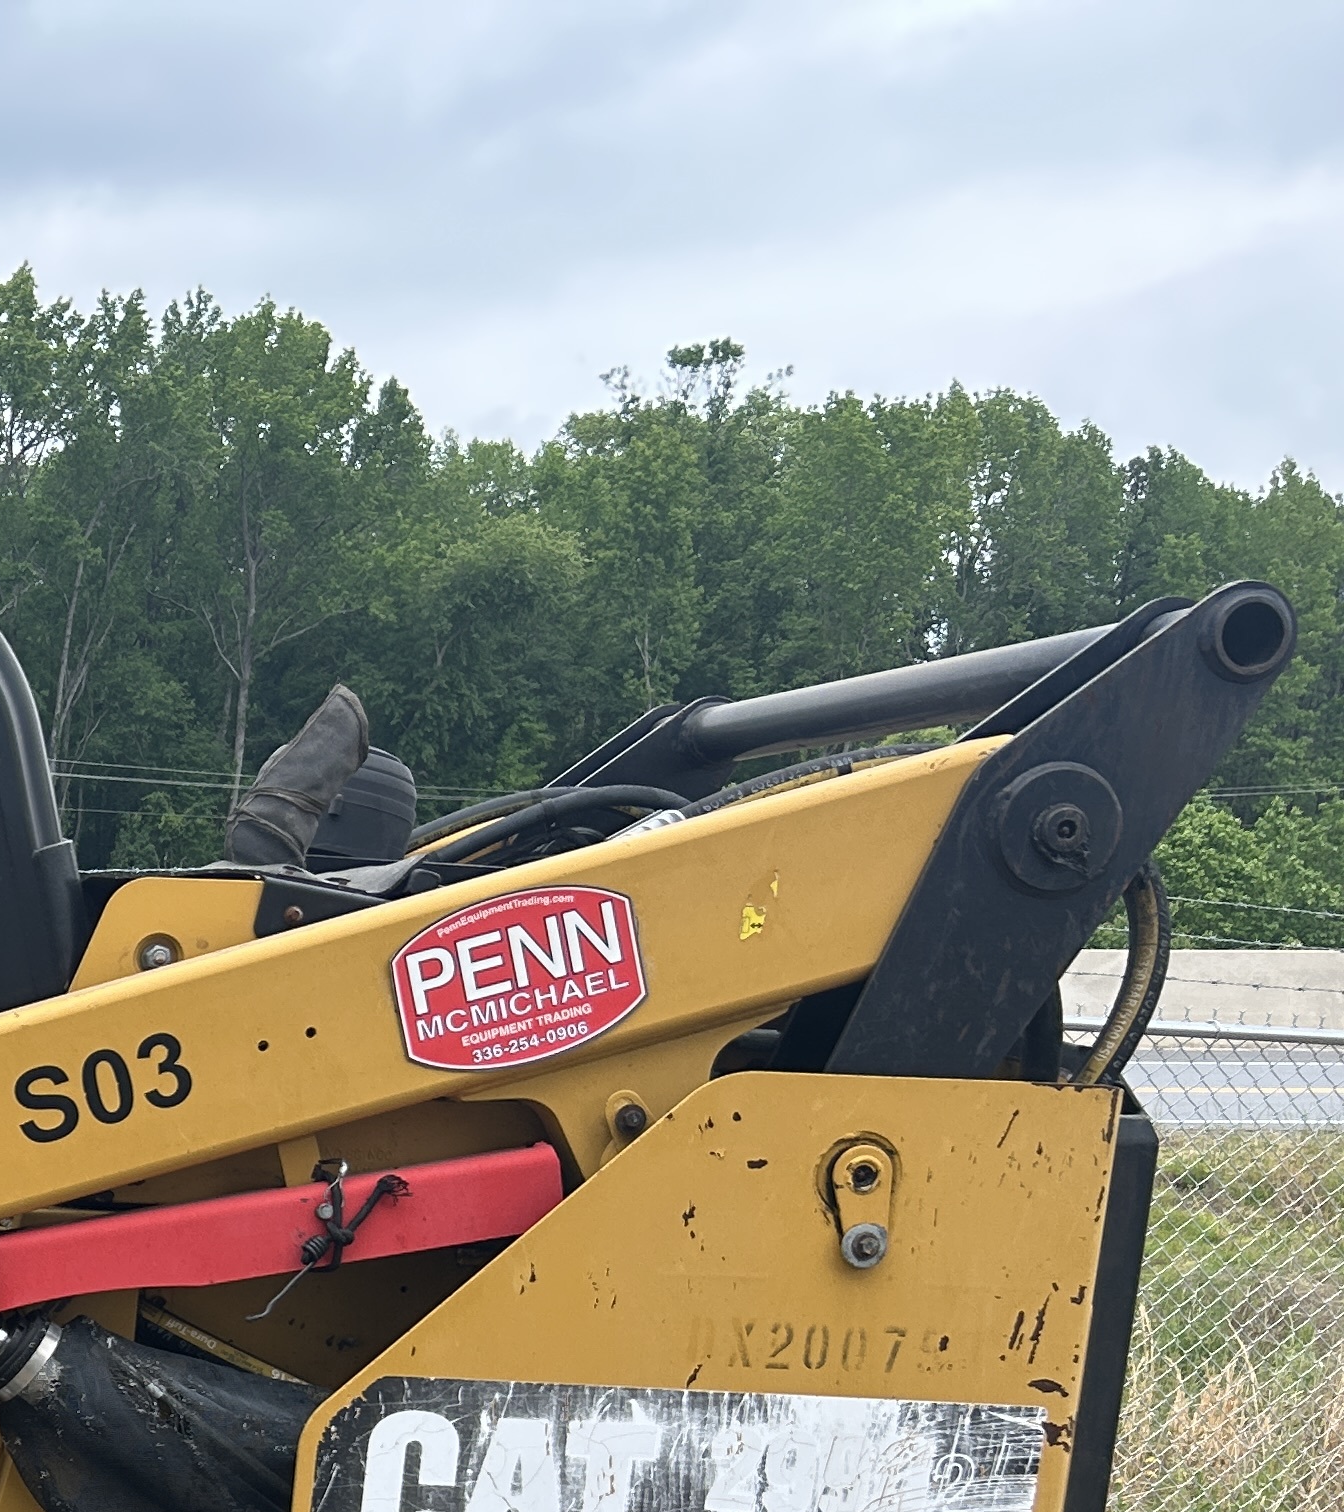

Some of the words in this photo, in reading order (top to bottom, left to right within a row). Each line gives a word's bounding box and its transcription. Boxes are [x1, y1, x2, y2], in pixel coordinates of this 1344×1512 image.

[436, 894, 575, 938] PennEquipmentTrading.com
[405, 900, 623, 1016] PENN
[416, 968, 630, 1041] MCMICHAEL
[461, 1018, 533, 1047] EQUIPMENT
[535, 1002, 593, 1027] TRADING
[472, 1021, 588, 1063] 336-254-0906
[14, 1032, 193, 1143] S03
